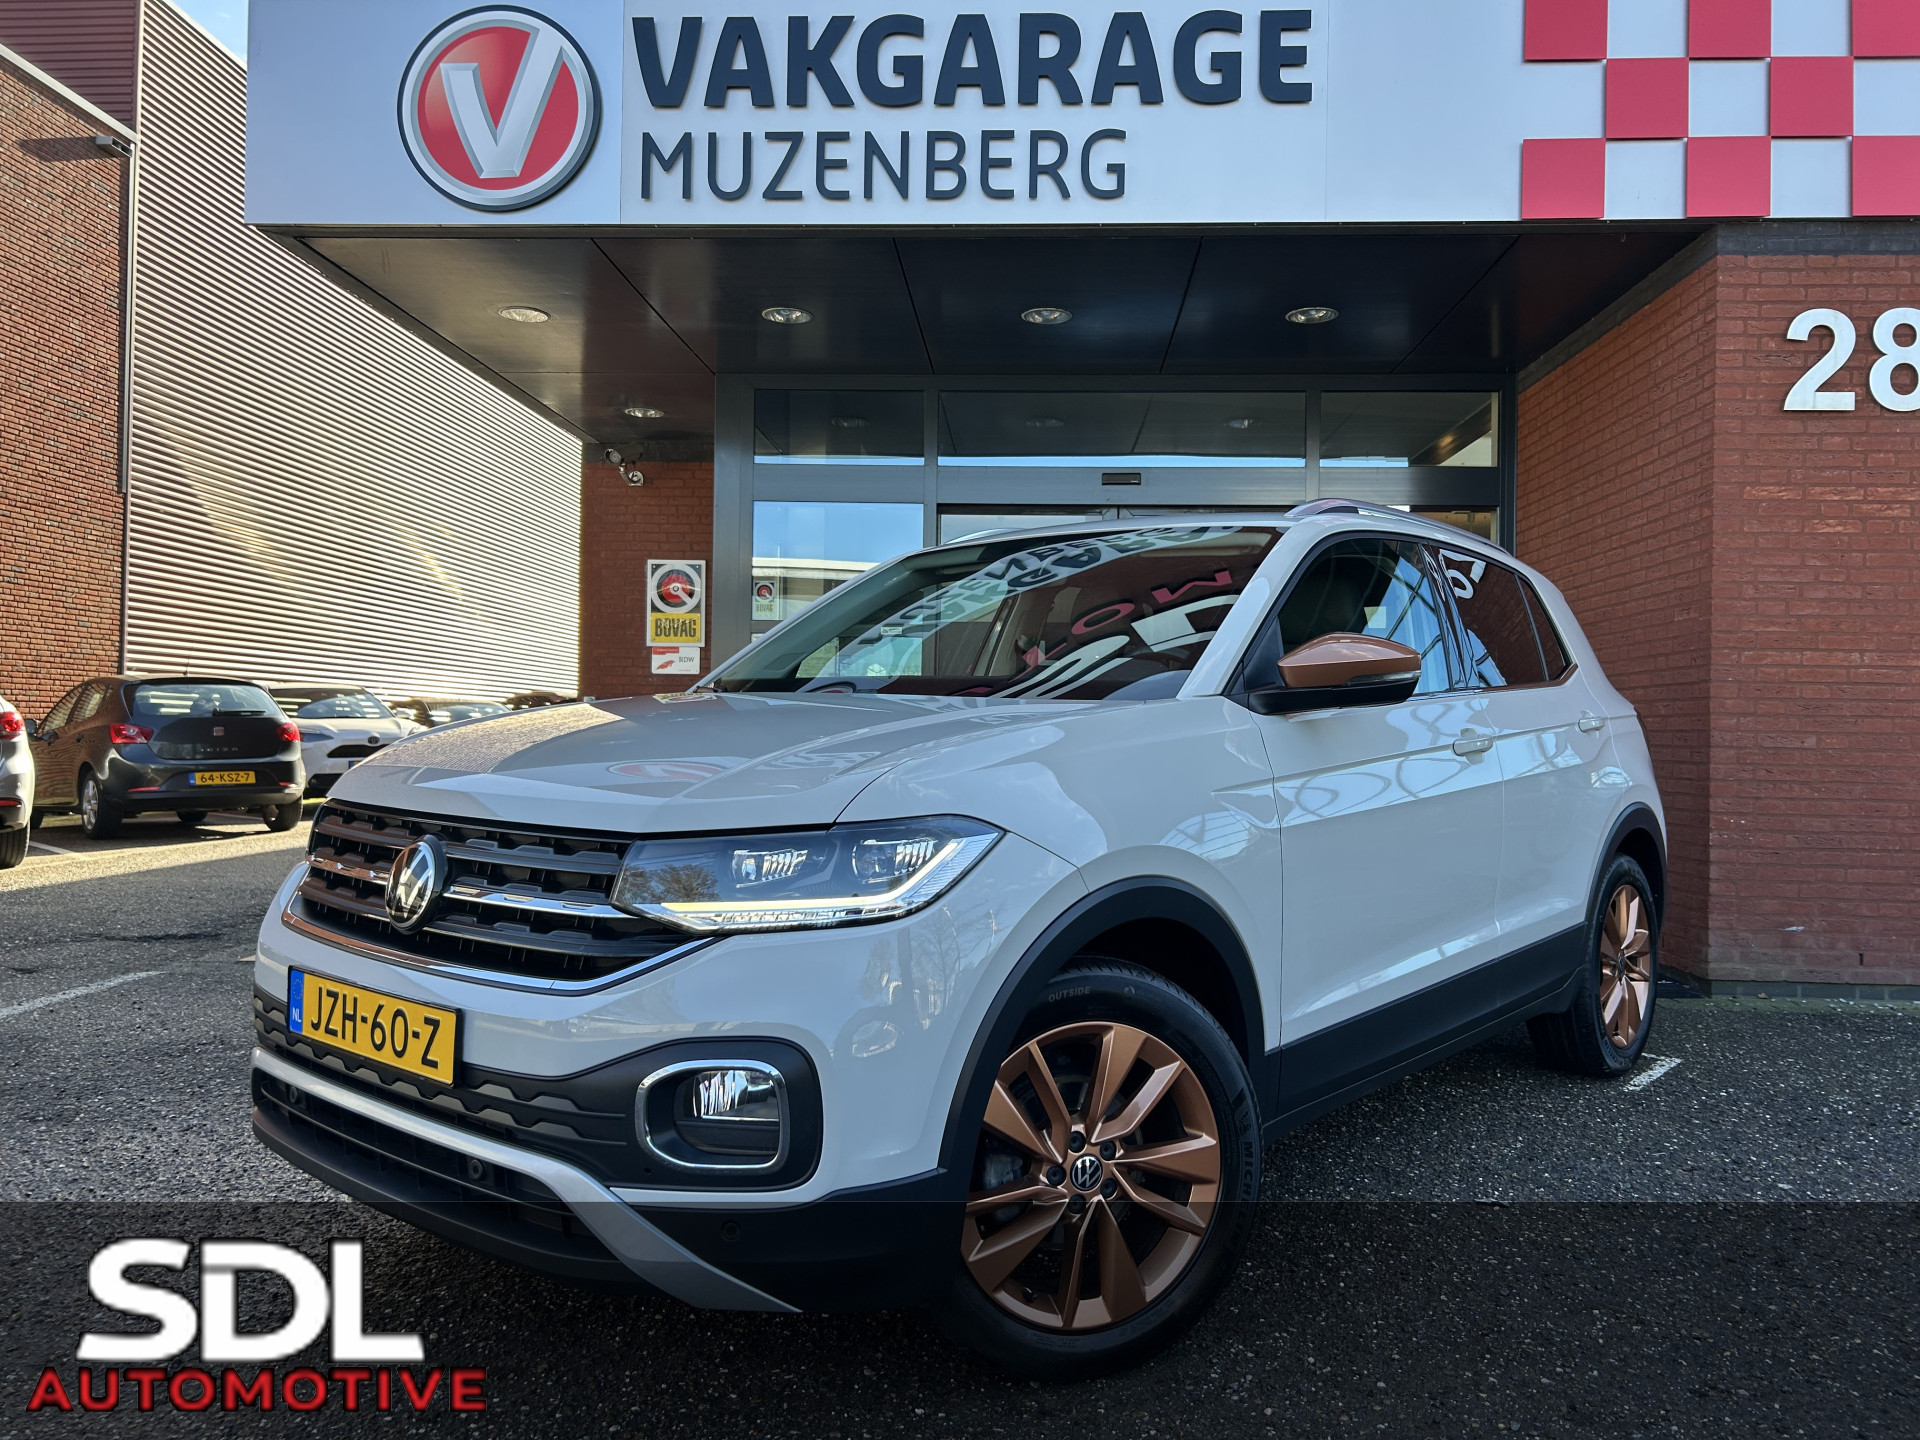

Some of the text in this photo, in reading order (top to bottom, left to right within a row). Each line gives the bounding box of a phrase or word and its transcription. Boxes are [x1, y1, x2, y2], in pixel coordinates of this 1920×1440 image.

[632, 10, 1313, 109] VAKGARAGE
[641, 129, 1127, 201] MUZENBERG
[1783, 307, 1920, 412] 28
[654, 617, 697, 638] BOVAG
[200, 772, 250, 783] 64-KSZ-7
[292, 1007, 302, 1023] NL
[1049, 985, 1091, 1002] OUTSIDE
[310, 985, 441, 1070] JZH-60-Z
